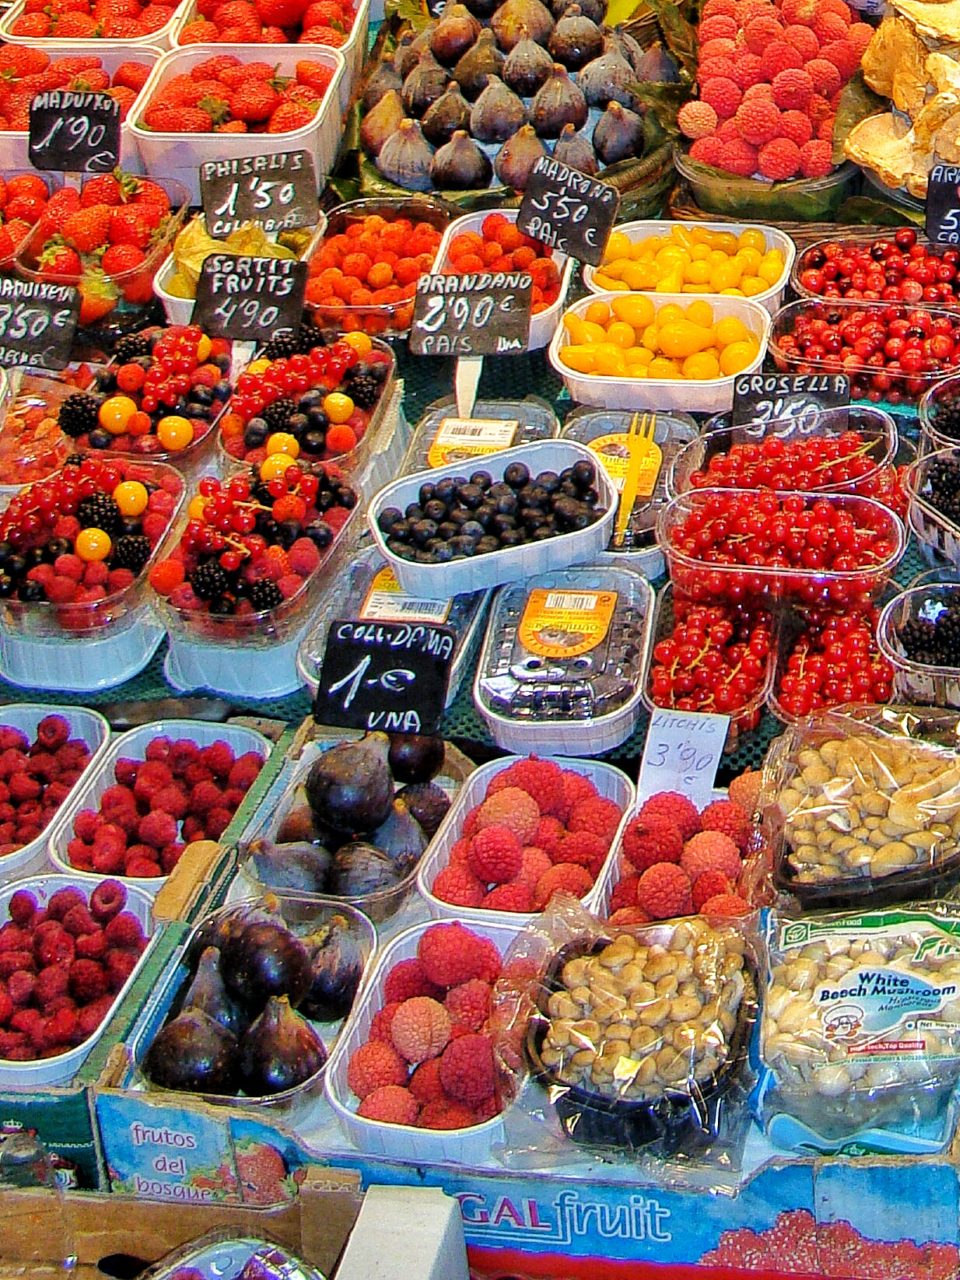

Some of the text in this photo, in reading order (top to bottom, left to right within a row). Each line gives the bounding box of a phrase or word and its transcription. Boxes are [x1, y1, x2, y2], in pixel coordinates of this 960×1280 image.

[32, 92, 120, 117] MADUIXOT
[32, 116, 106, 151] 1'90
[203, 154, 304, 181] PHISALIS
[214, 177, 295, 217] 1'50
[531, 186, 589, 224] 5'50
[585, 228, 599, 247] €
[207, 256, 297, 275] SORTIT
[211, 272, 296, 296] FRUITS
[416, 272, 533, 295] ARANDANO
[52, 309, 71, 327] €
[214, 296, 280, 330] 4'90
[416, 295, 496, 333] 2'90
[736, 373, 850, 395] GROSELLA
[367, 710, 421, 733] UNA
[652, 714, 717, 734] LITCHIS
[647, 742, 714, 774] 3'90
[857, 972, 910, 987] White
[819, 982, 956, 1002] Beech Mushroom
[132, 1123, 196, 1148] frutos
[154, 1155, 186, 1175] del
[135, 1175, 211, 1200] bosque
[553, 1189, 672, 1245] fruit
